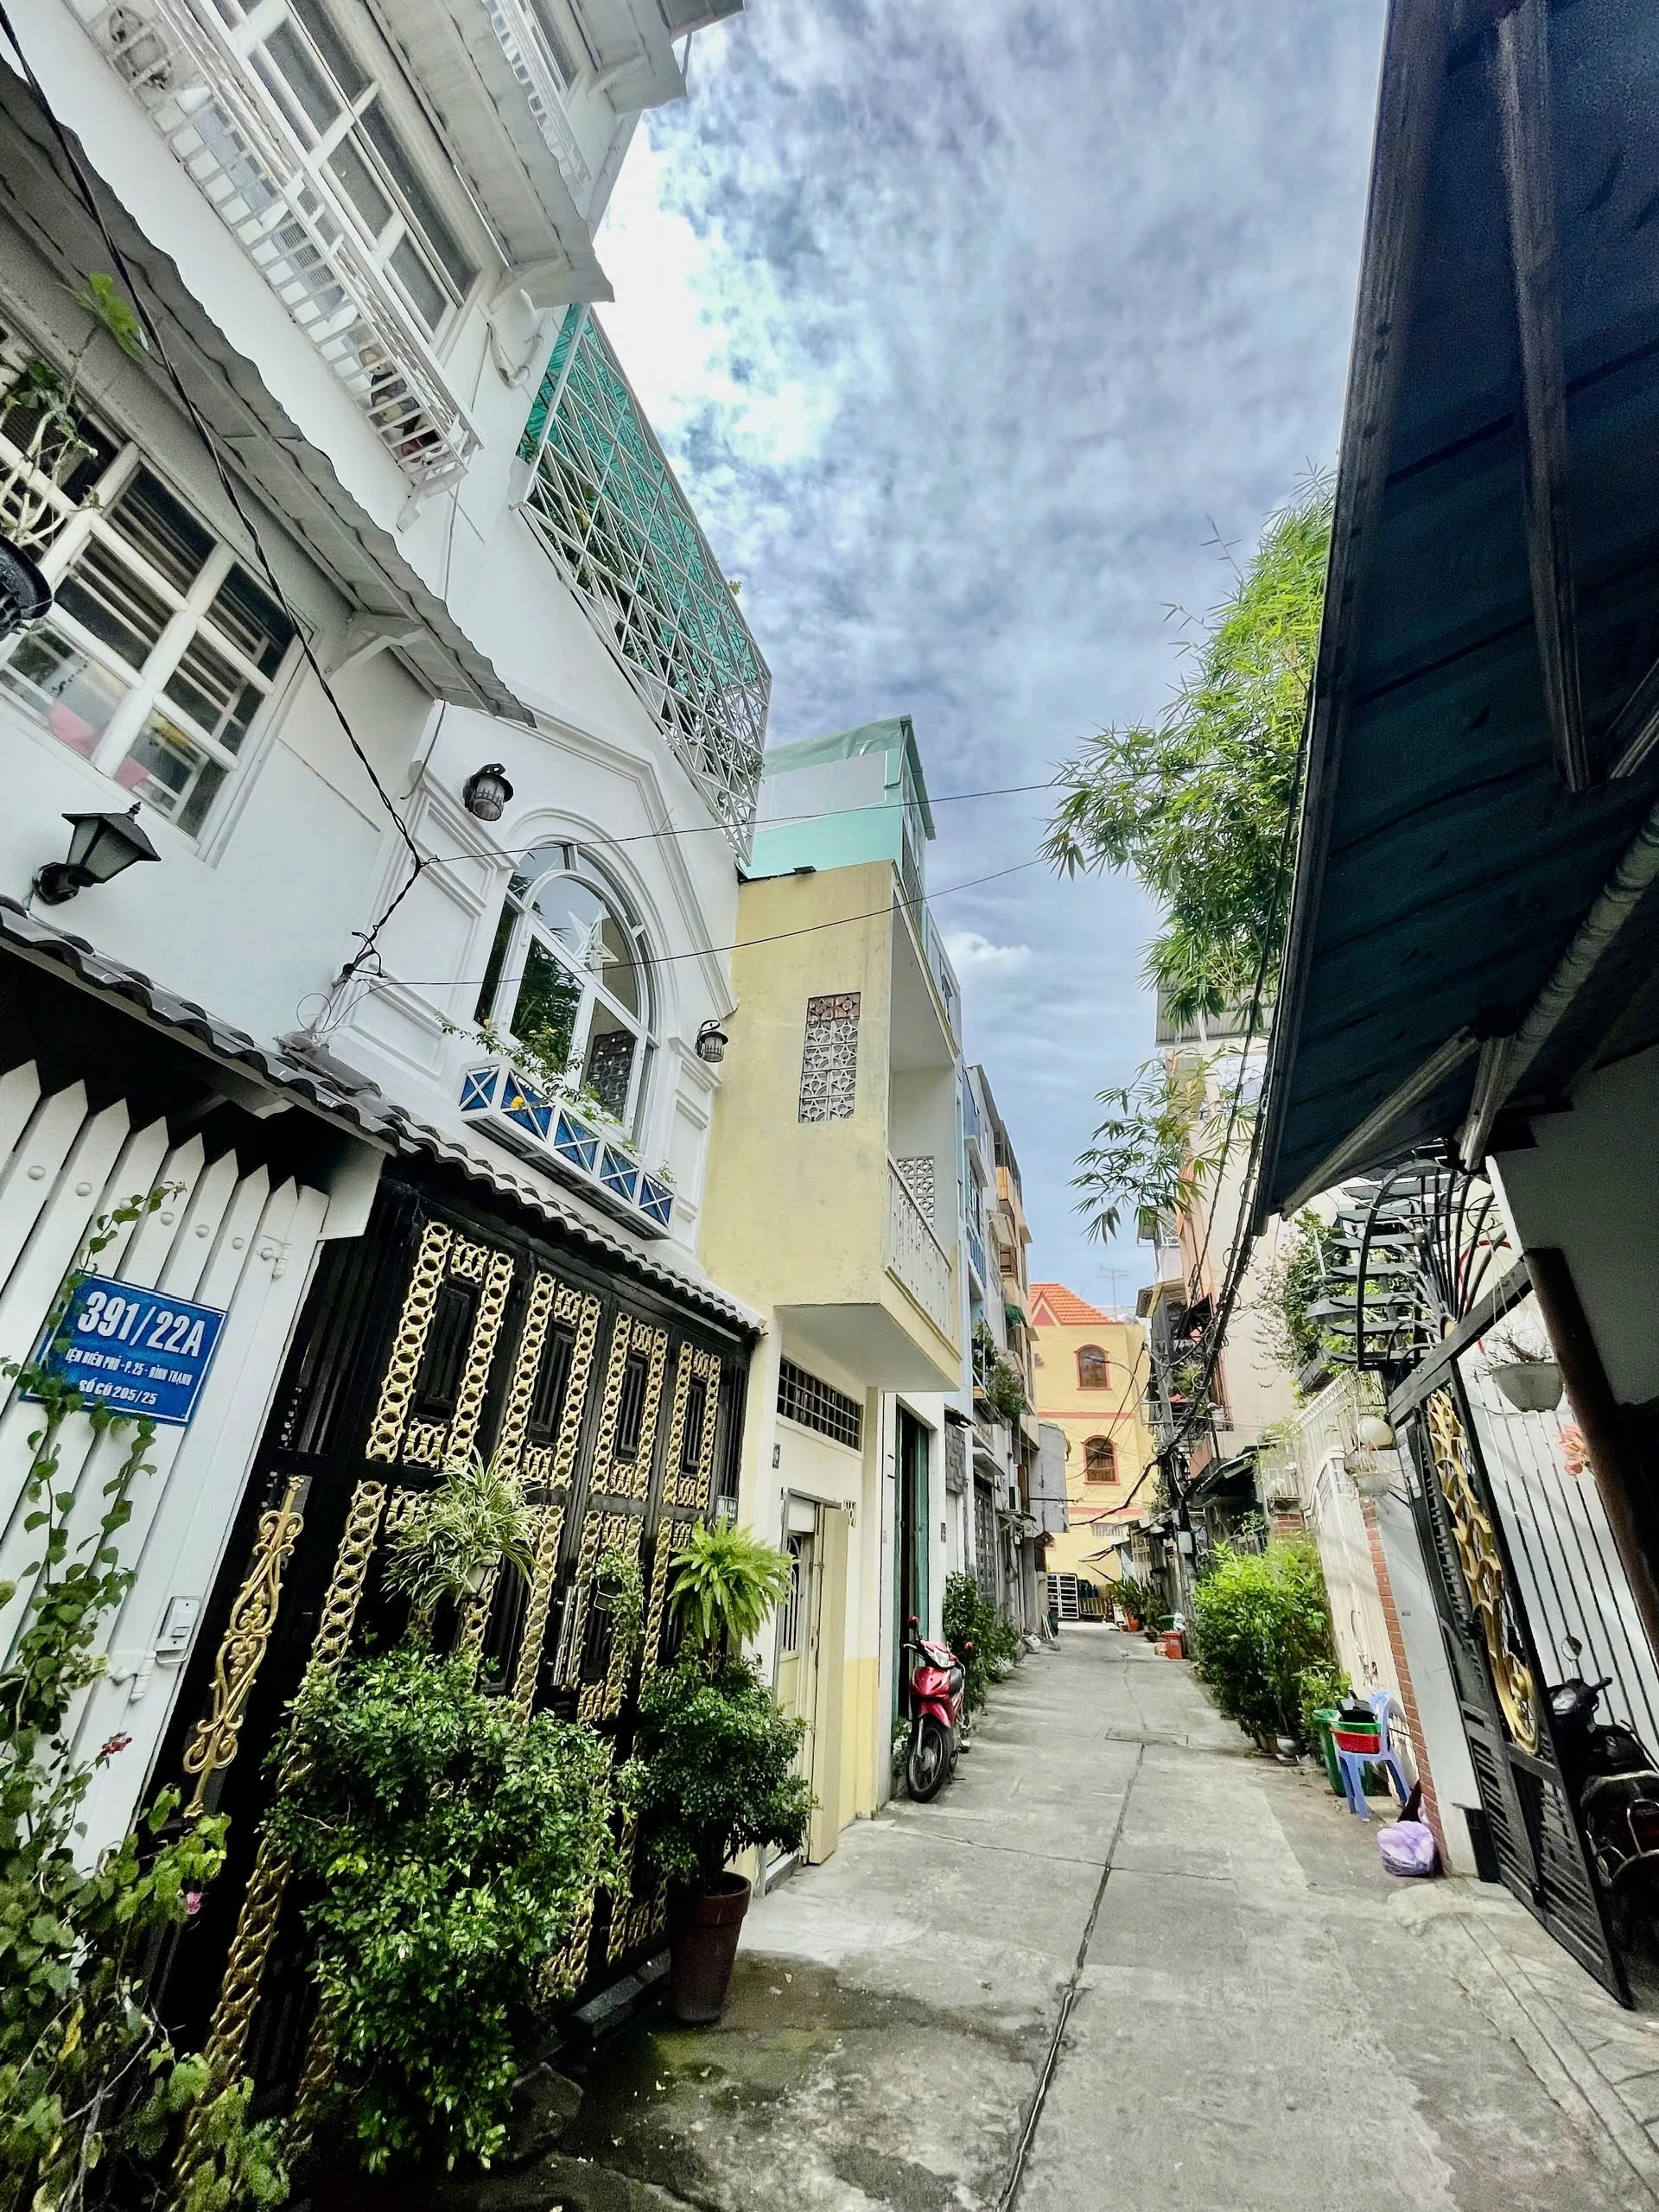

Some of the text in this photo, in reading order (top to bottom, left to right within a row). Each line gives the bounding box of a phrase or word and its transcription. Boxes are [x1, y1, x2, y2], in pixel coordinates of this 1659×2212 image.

[77, 1291, 206, 1357] 391/22A
[64, 1347, 84, 1364] IỆN
[131, 1362, 145, 1376] 25
[111, 1386, 158, 1405] 205/25
